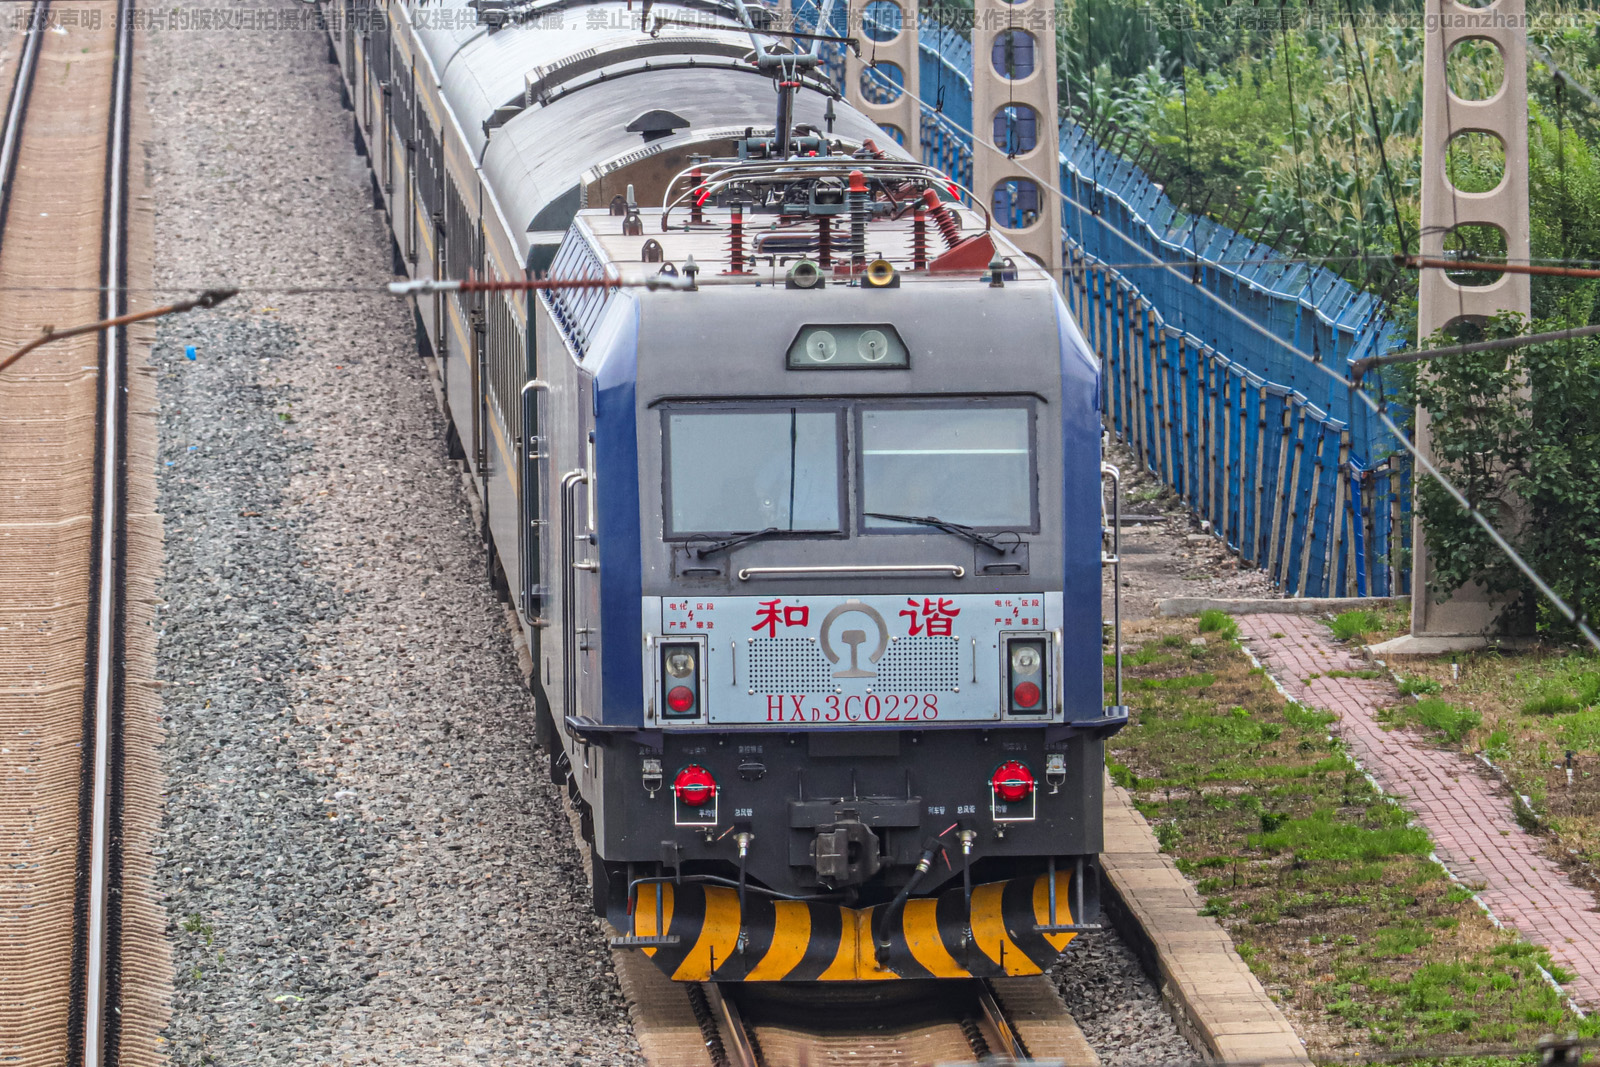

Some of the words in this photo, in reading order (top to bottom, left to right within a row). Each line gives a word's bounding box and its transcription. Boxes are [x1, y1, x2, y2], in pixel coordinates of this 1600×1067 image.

[669, 602, 714, 611] 电化区段
[994, 599, 1039, 607] 电化区段
[751, 598, 809, 639] 和
[899, 597, 961, 638] 谐
[994, 617, 1039, 626] 严禁攀登
[669, 621, 714, 630] 严禁攀登
[766, 693, 939, 722] HXD3C0228
